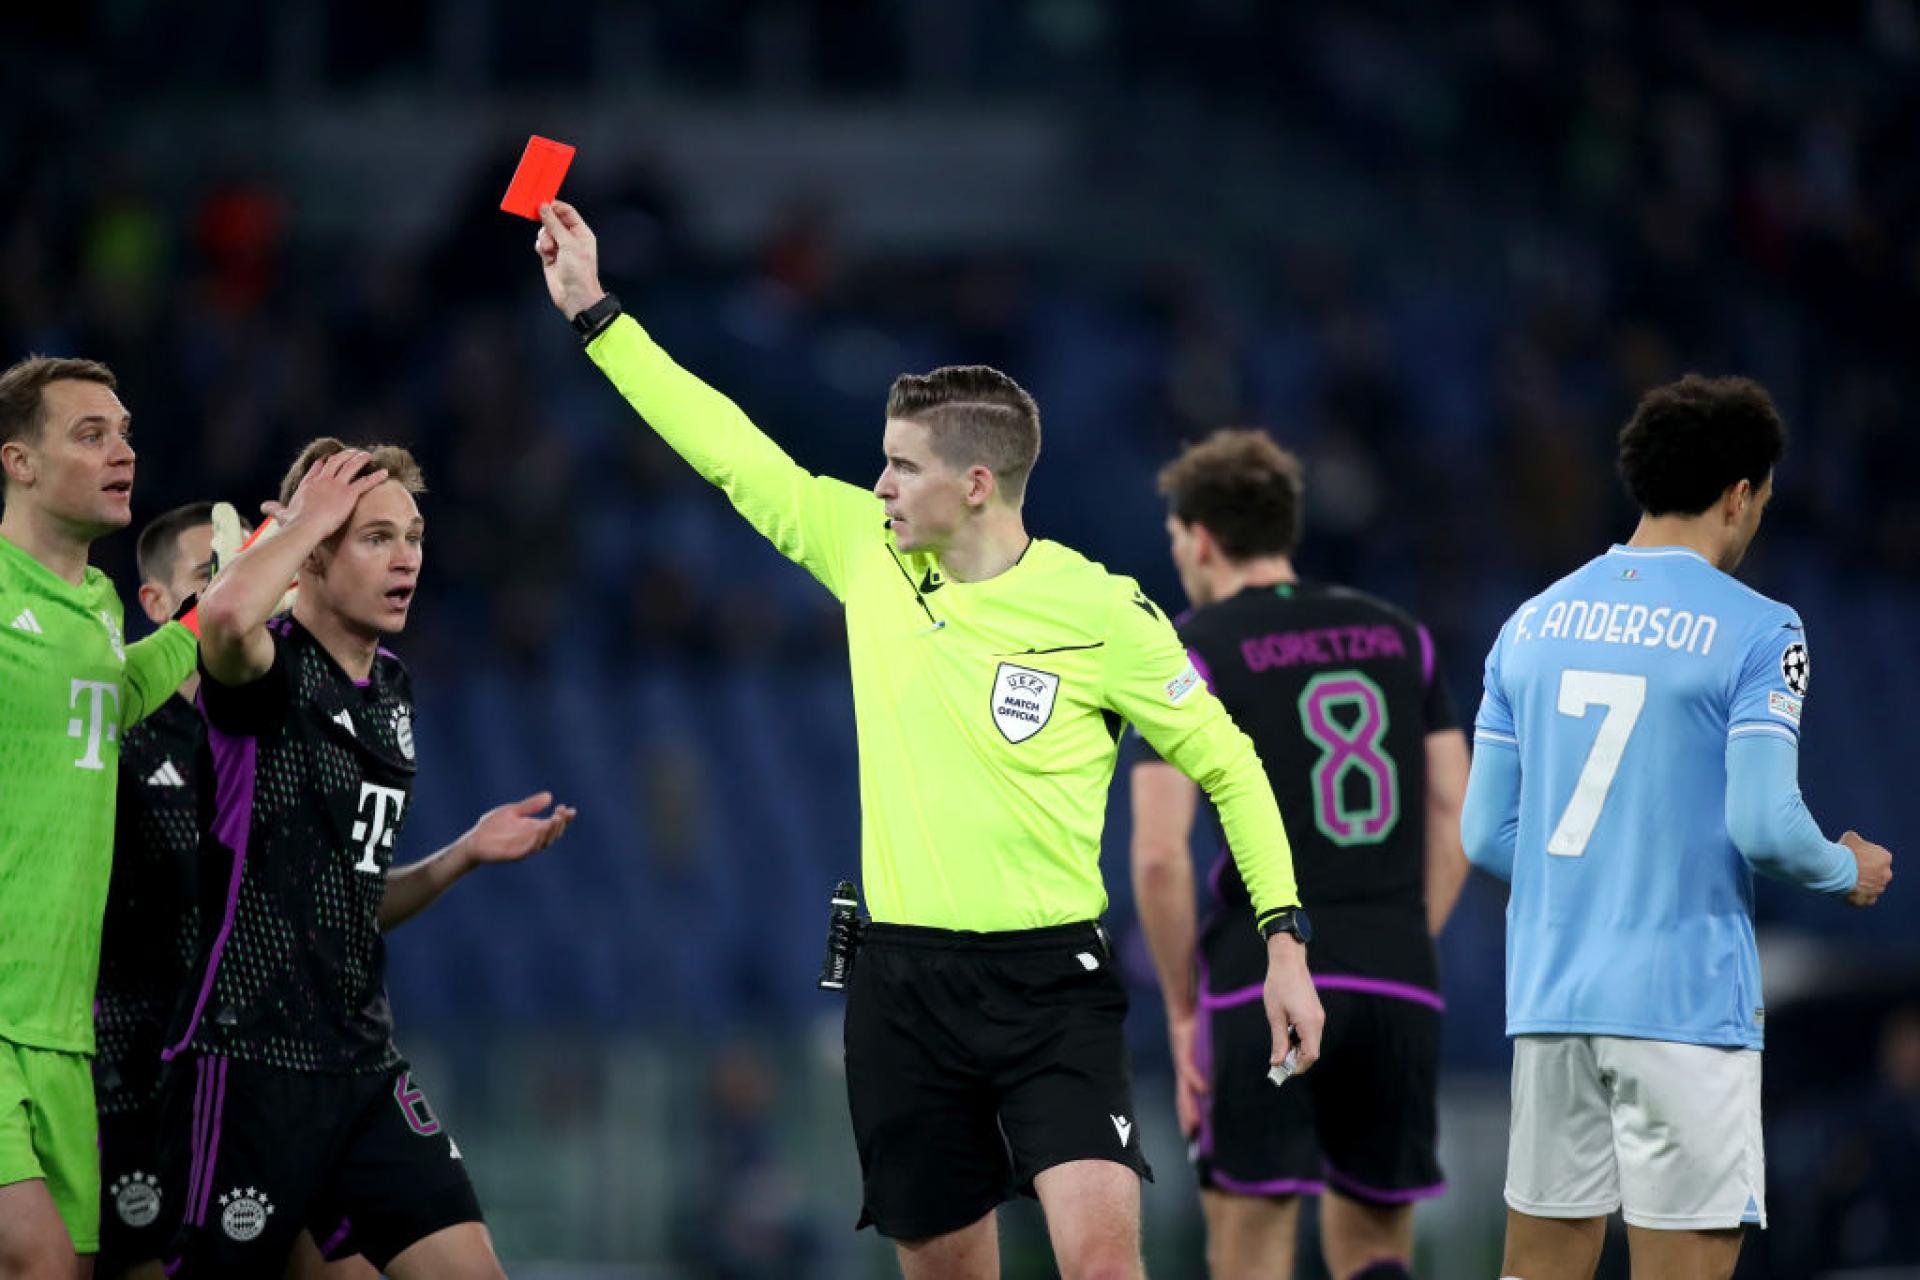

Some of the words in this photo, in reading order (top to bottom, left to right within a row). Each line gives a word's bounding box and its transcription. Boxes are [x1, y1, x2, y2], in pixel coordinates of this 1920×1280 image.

[1514, 606, 1538, 645] F.
[1539, 600, 1718, 656] ANDERSON
[997, 706, 1040, 724] OFFICIAL
[1004, 696, 1040, 711] MATCH
[1008, 676, 1043, 694] UEFA
[67, 677, 120, 769] T
[1298, 669, 1400, 847] 8
[1546, 669, 1647, 857] 7
[352, 781, 406, 874] T
